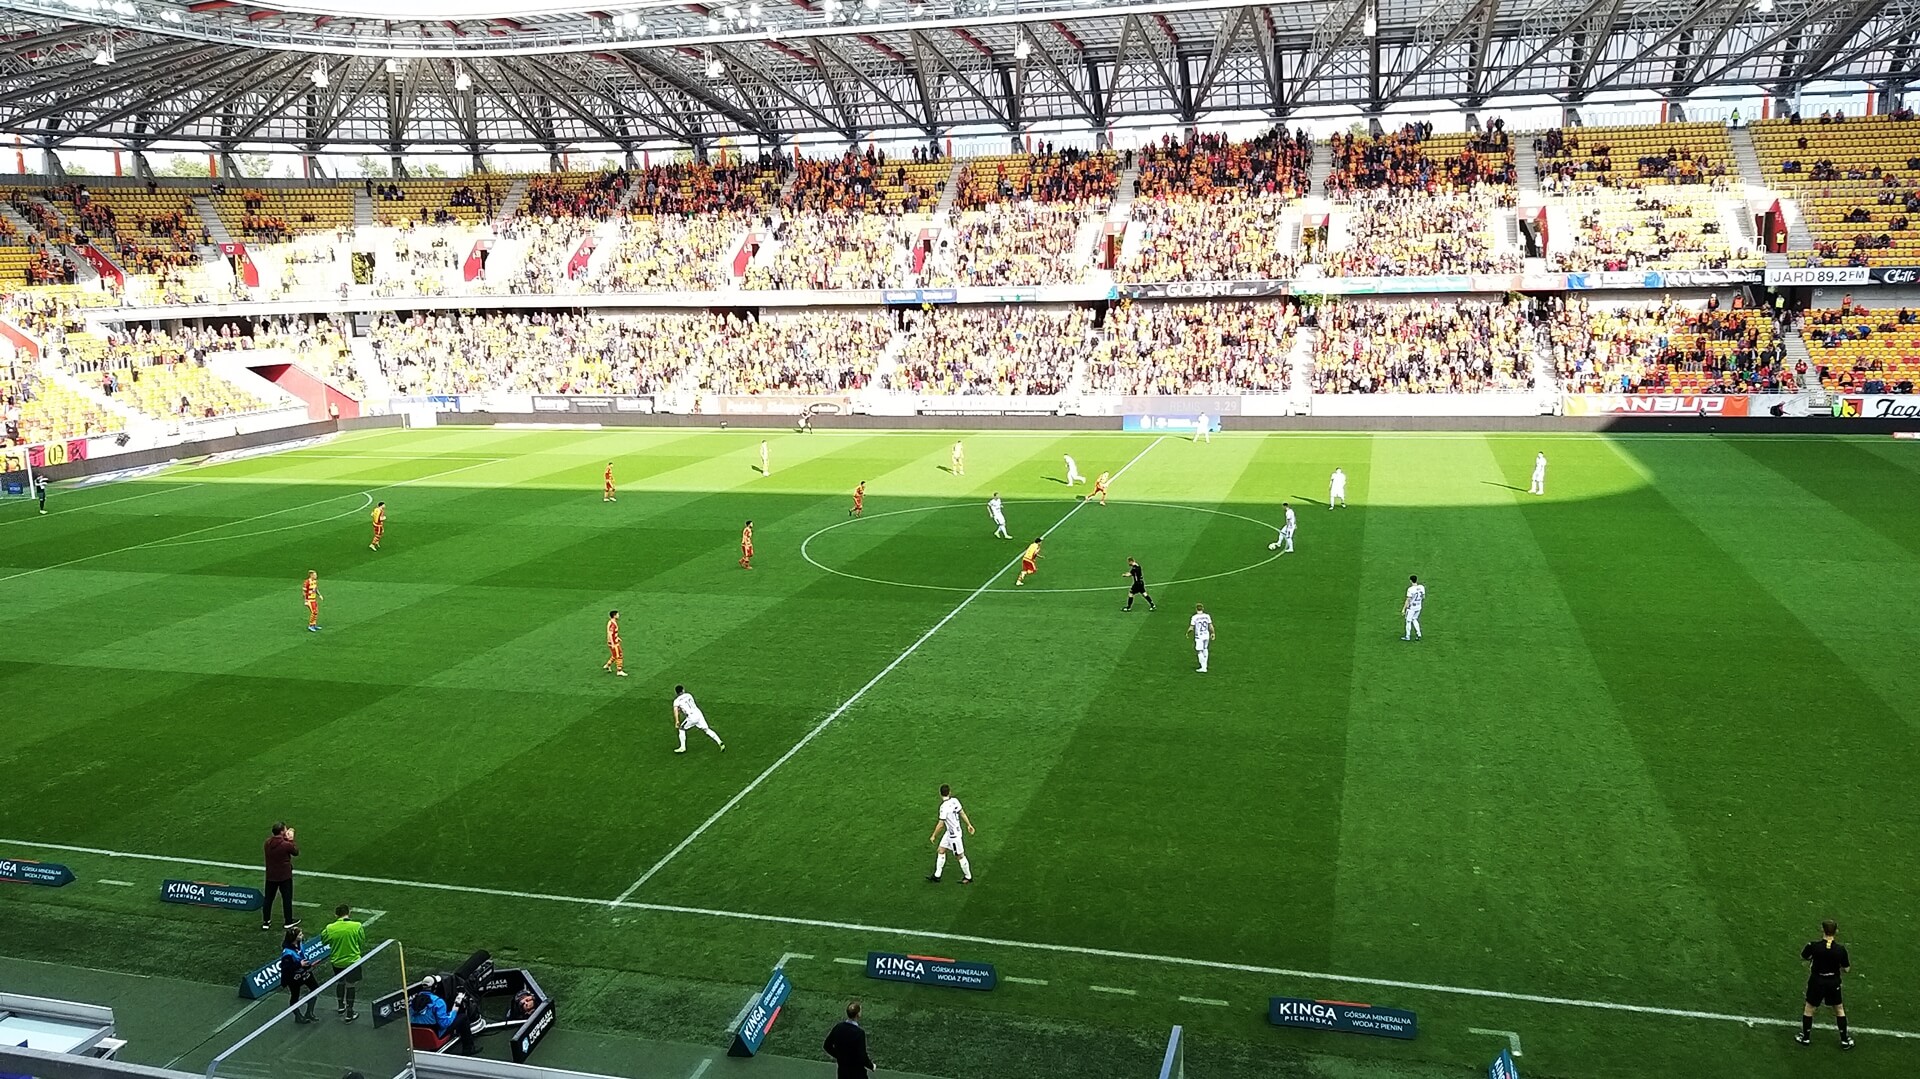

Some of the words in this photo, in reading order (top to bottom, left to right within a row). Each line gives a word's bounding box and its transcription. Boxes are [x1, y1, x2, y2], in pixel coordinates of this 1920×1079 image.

[1774, 271, 1815, 282] JARD
[1817, 271, 1847, 283] 89,2
[1849, 271, 1865, 279] FM
[1594, 396, 1725, 411] ANBUD
[1876, 398, 1920, 418] Jag
[167, 883, 205, 897] KINGA
[253, 960, 282, 987] KIN
[875, 957, 925, 975] KINGA
[1279, 1002, 1338, 1020] KINGA
[1344, 1010, 1371, 1020] GÓRSKA
[1372, 1014, 1412, 1025] MINERALNA
[743, 1005, 767, 1041] KINGA
[1351, 1019, 1374, 1029] WODA
[1380, 1023, 1403, 1032] PIENIN
